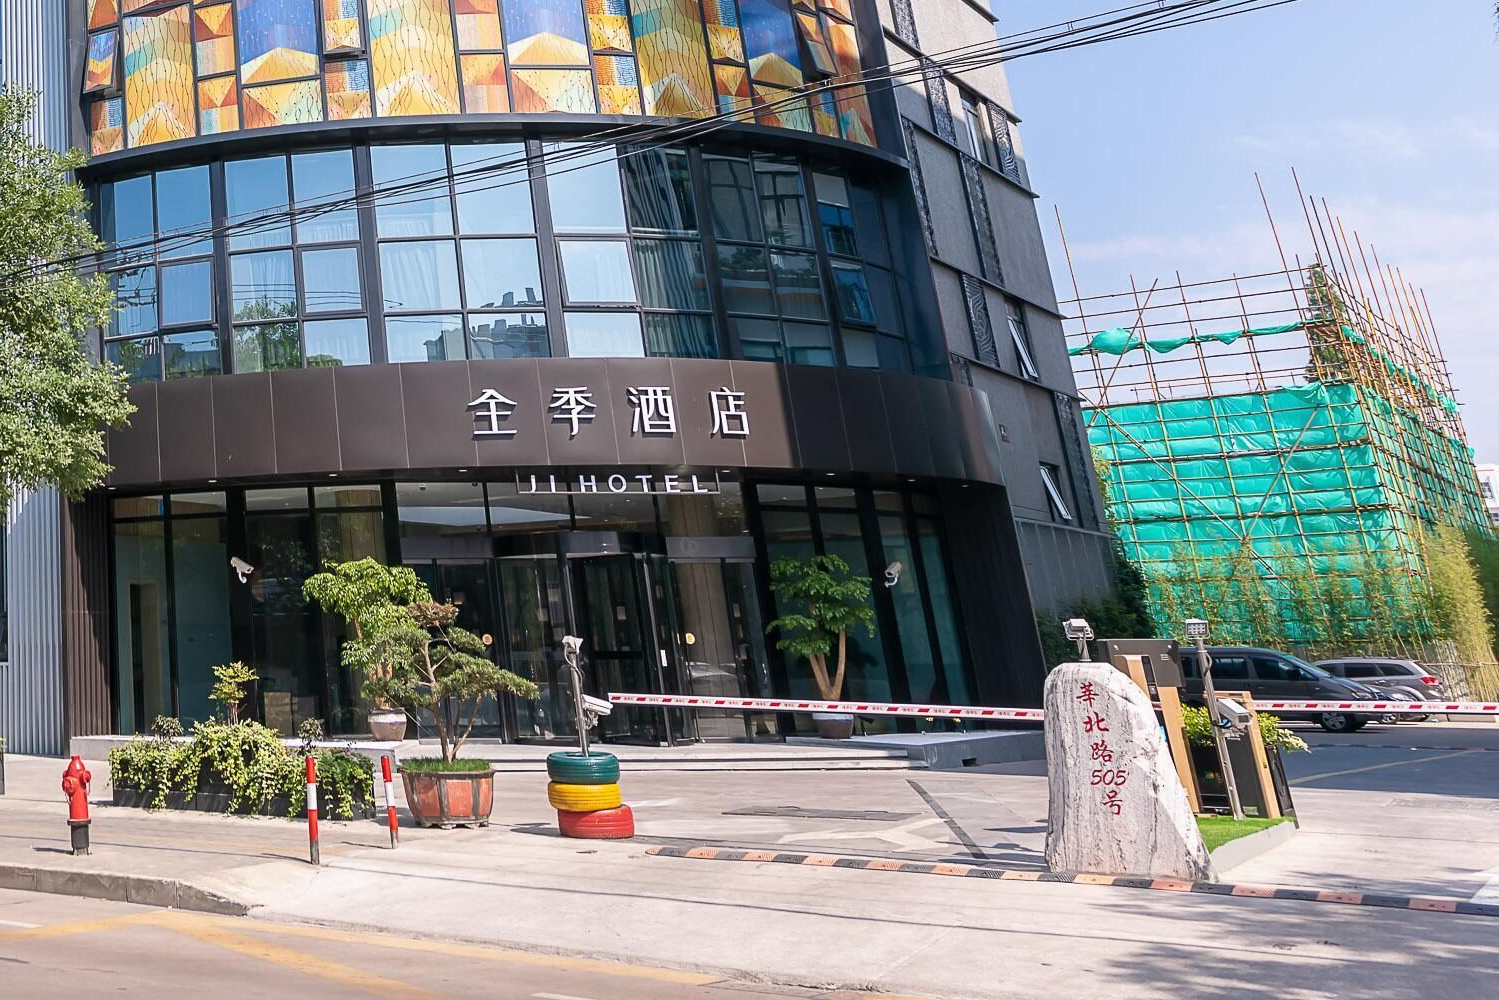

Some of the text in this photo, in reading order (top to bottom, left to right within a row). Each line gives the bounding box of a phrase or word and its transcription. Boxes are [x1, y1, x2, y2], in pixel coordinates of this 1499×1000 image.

[467, 386, 750, 436] 全季酒店
[529, 474, 709, 493] JI HOTEL
